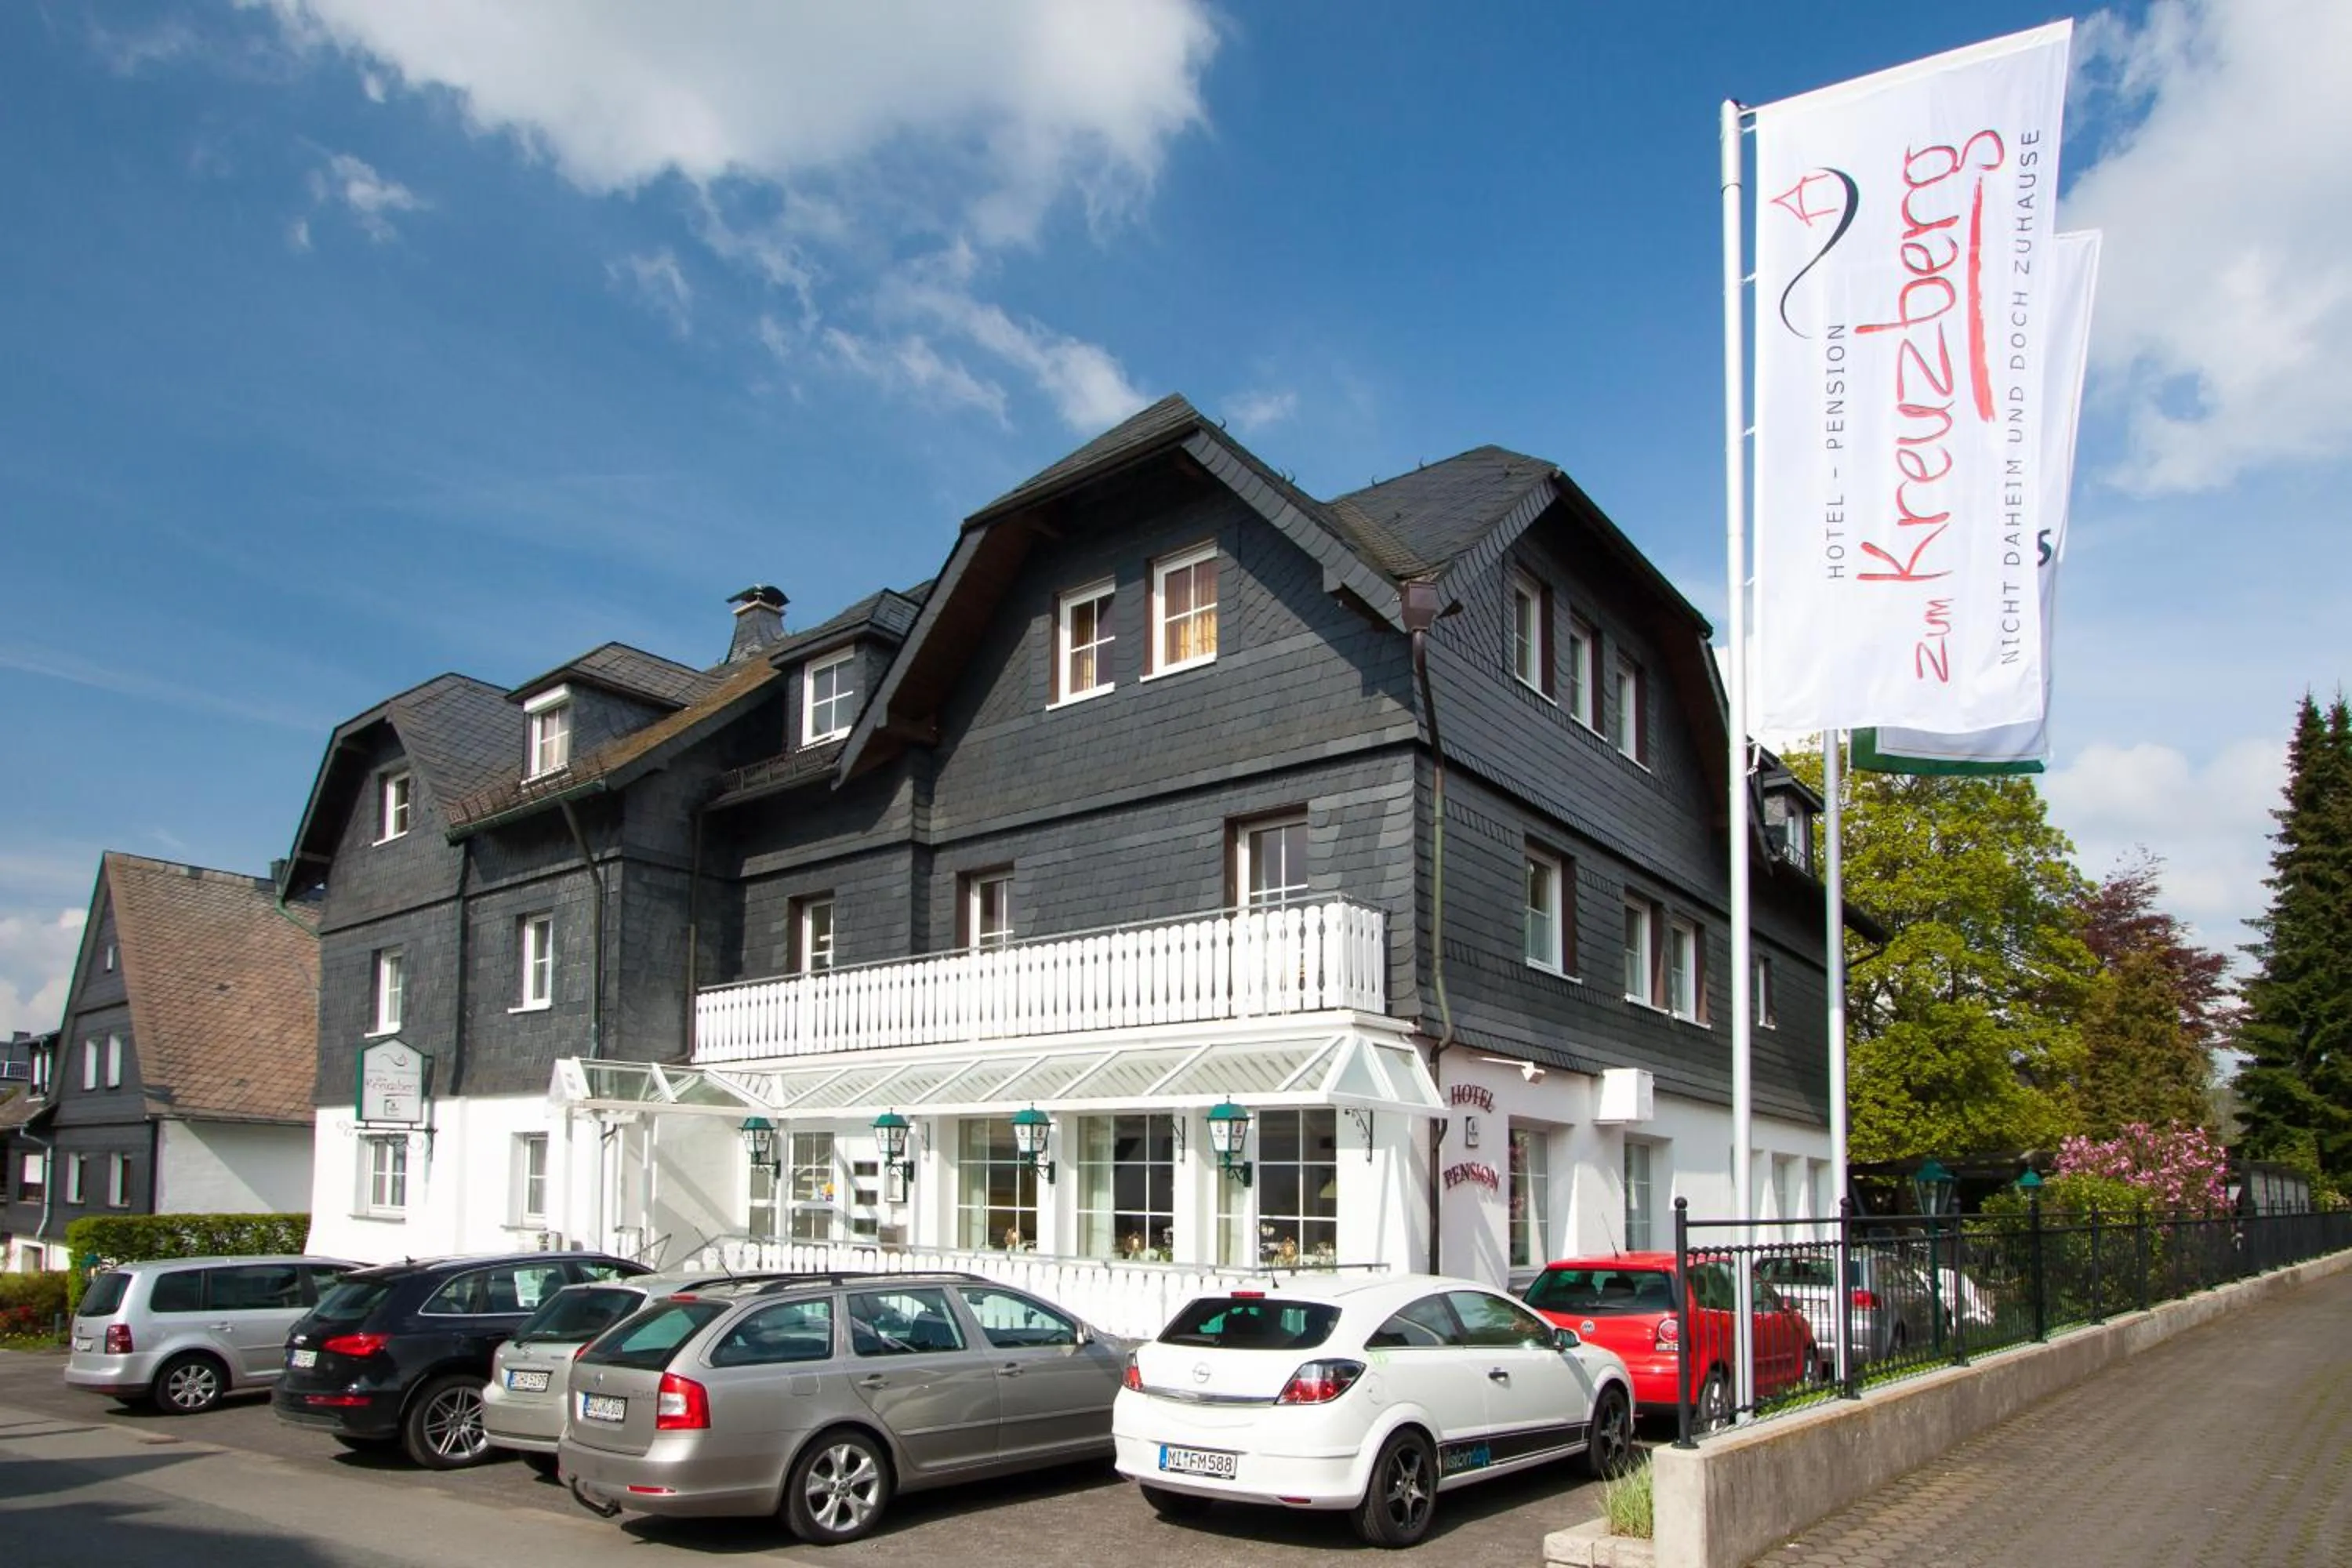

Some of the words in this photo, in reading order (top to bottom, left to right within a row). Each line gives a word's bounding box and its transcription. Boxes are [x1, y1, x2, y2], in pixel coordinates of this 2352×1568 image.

[2014, 129, 2040, 275] ZUHAUSE
[1855, 129, 2005, 583] Kreuzberg
[2009, 292, 2028, 370] DOCH
[1826, 324, 1846, 450] PENSION
[2007, 387, 2025, 443] UND
[1826, 495, 1846, 579] HOTEL
[2003, 459, 2023, 566] DAHEIM
[2001, 582, 2020, 665] NICHT
[1450, 1083, 1495, 1114] HOTEL
[1443, 1161, 1501, 1192] PENSION
